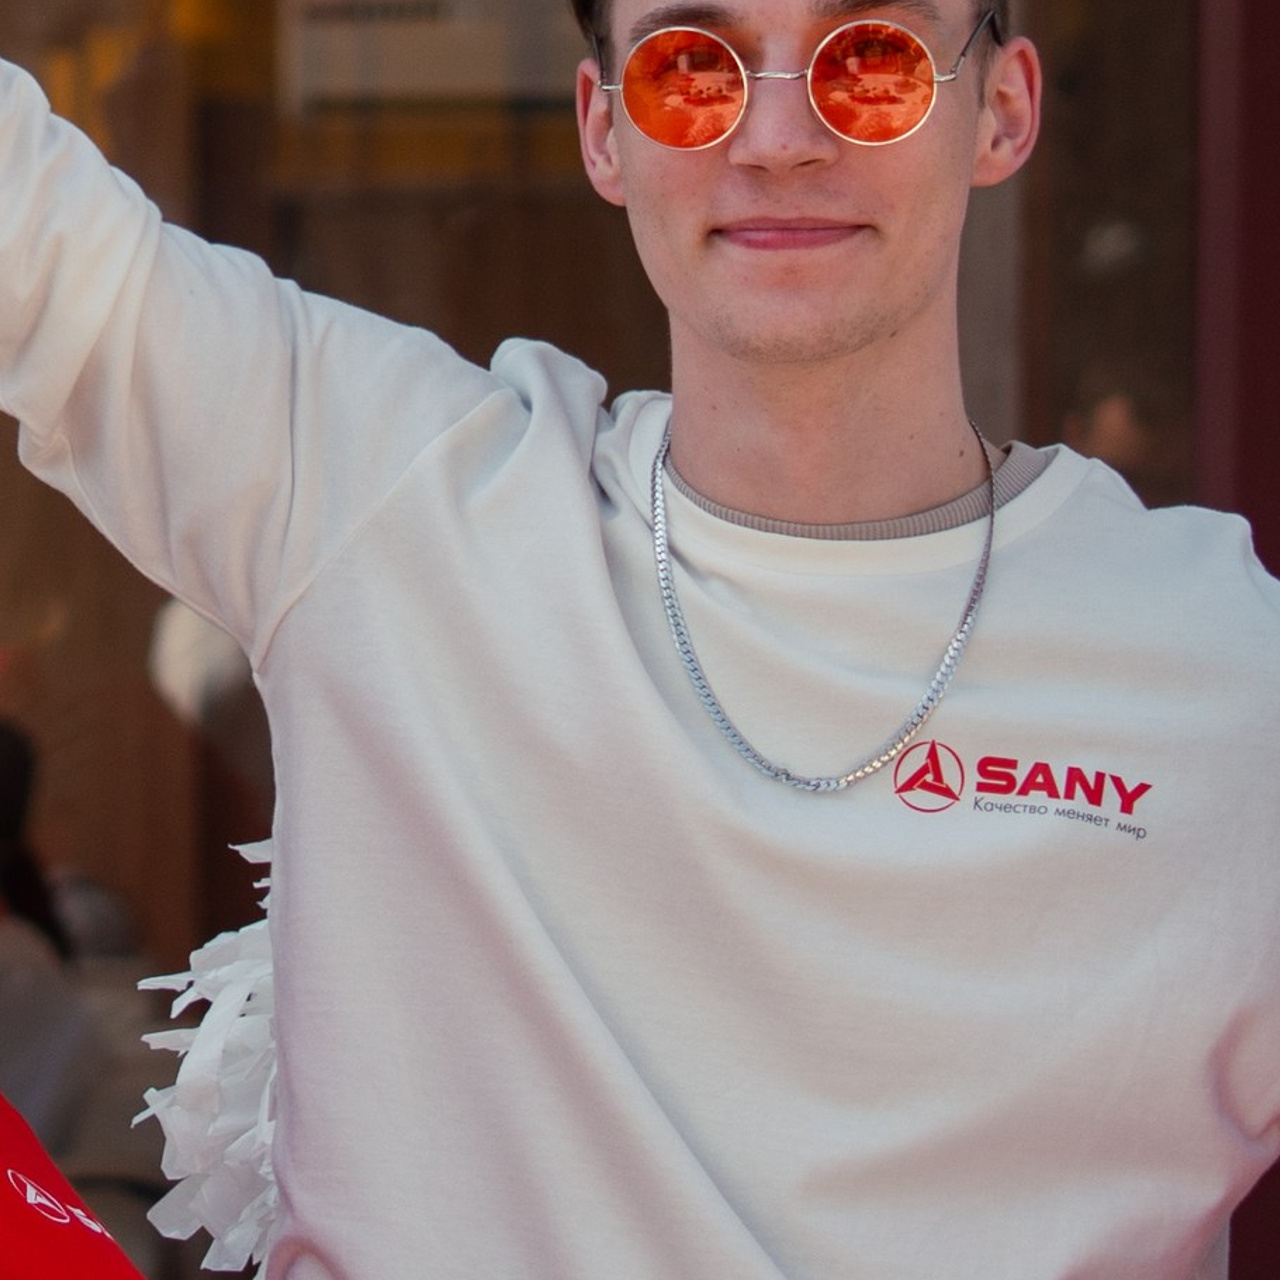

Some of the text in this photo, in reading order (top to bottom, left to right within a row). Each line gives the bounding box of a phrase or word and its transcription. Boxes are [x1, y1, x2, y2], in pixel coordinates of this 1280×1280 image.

[975, 755, 1153, 816] SANY
[972, 795, 1147, 840] Качество меняет мир
